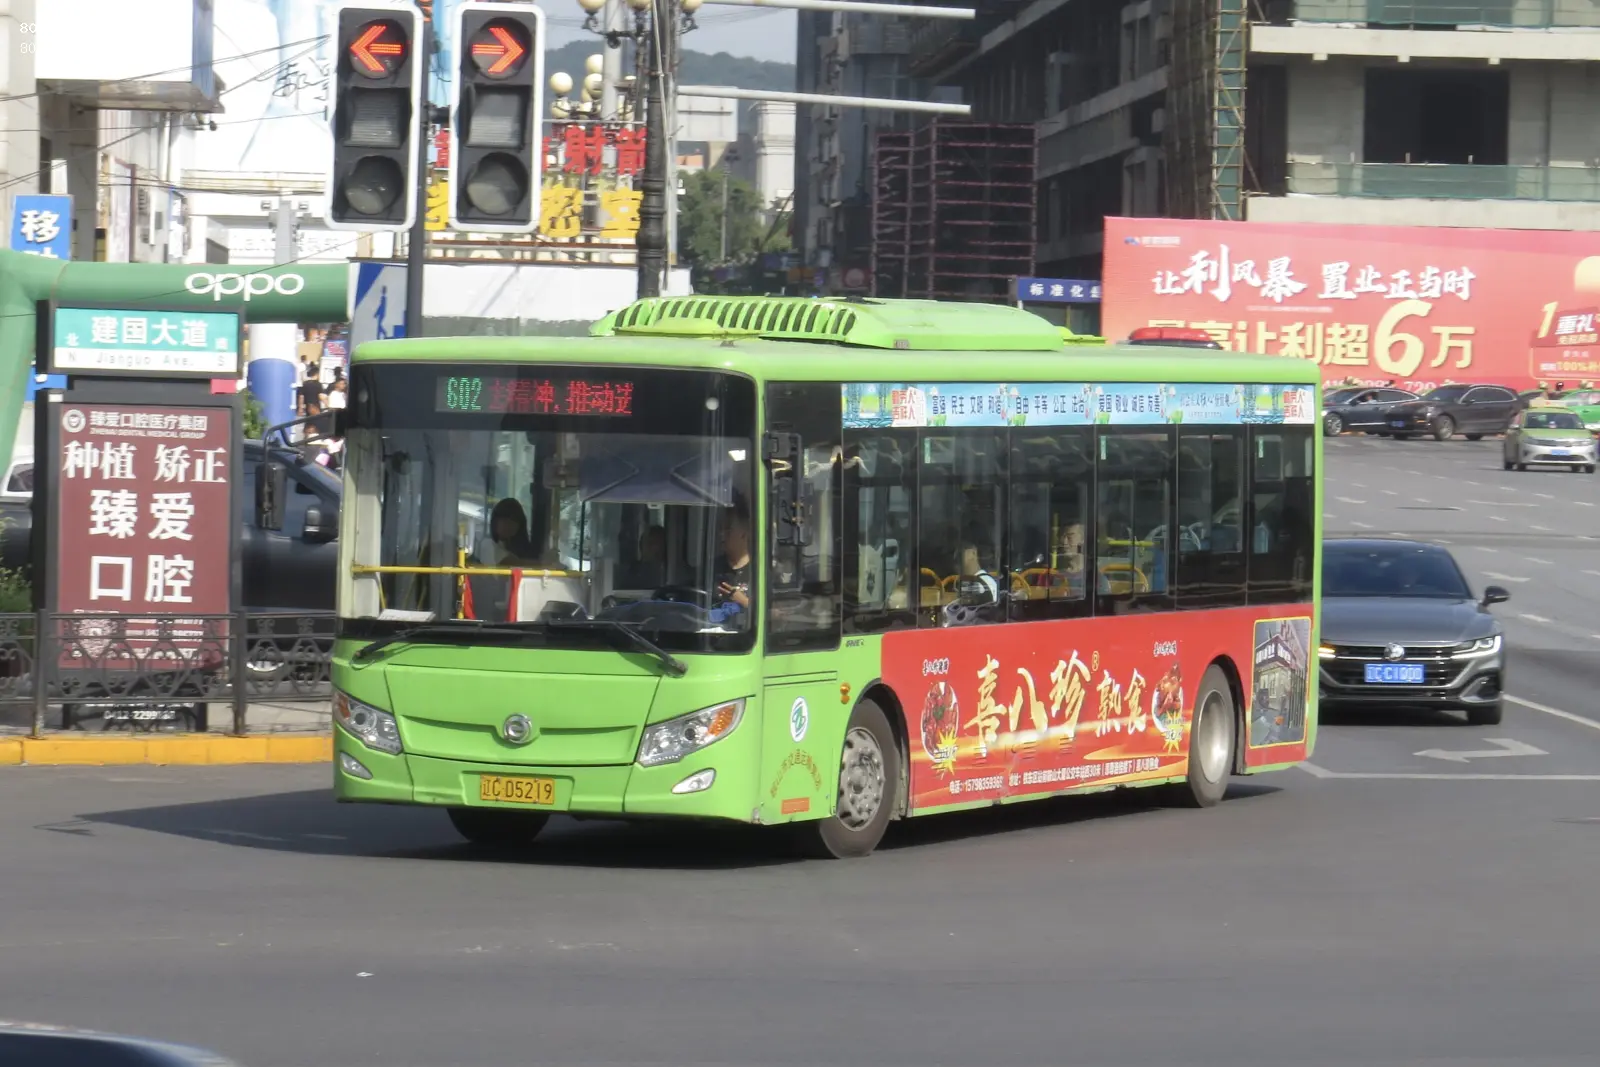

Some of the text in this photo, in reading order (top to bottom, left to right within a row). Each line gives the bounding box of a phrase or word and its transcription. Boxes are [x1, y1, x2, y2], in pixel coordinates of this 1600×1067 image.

[1152, 244, 1475, 302] 让利风暴 置业正当时
[65, 332, 79, 347] 北
[91, 316, 208, 347] 建国大道
[68, 351, 76, 362] N
[96, 352, 150, 367] Jianguo
[217, 357, 225, 367] S
[447, 377, 482, 410] 602
[932, 395, 946, 415] 富强
[951, 395, 965, 415] 民主
[970, 395, 984, 415] 文明
[1015, 395, 1029, 414] 自由
[1034, 395, 1048, 414] 平等
[1053, 395, 1067, 414] 公正
[1098, 394, 1112, 413] 爱国
[1115, 394, 1129, 413] 敬业
[1131, 394, 1145, 413] 诚信
[89, 411, 208, 431] 臻爱口腔医疗集团
[62, 440, 227, 483] 种植 矫正
[89, 489, 195, 541] 臻爱
[90, 554, 194, 603] 口腔
